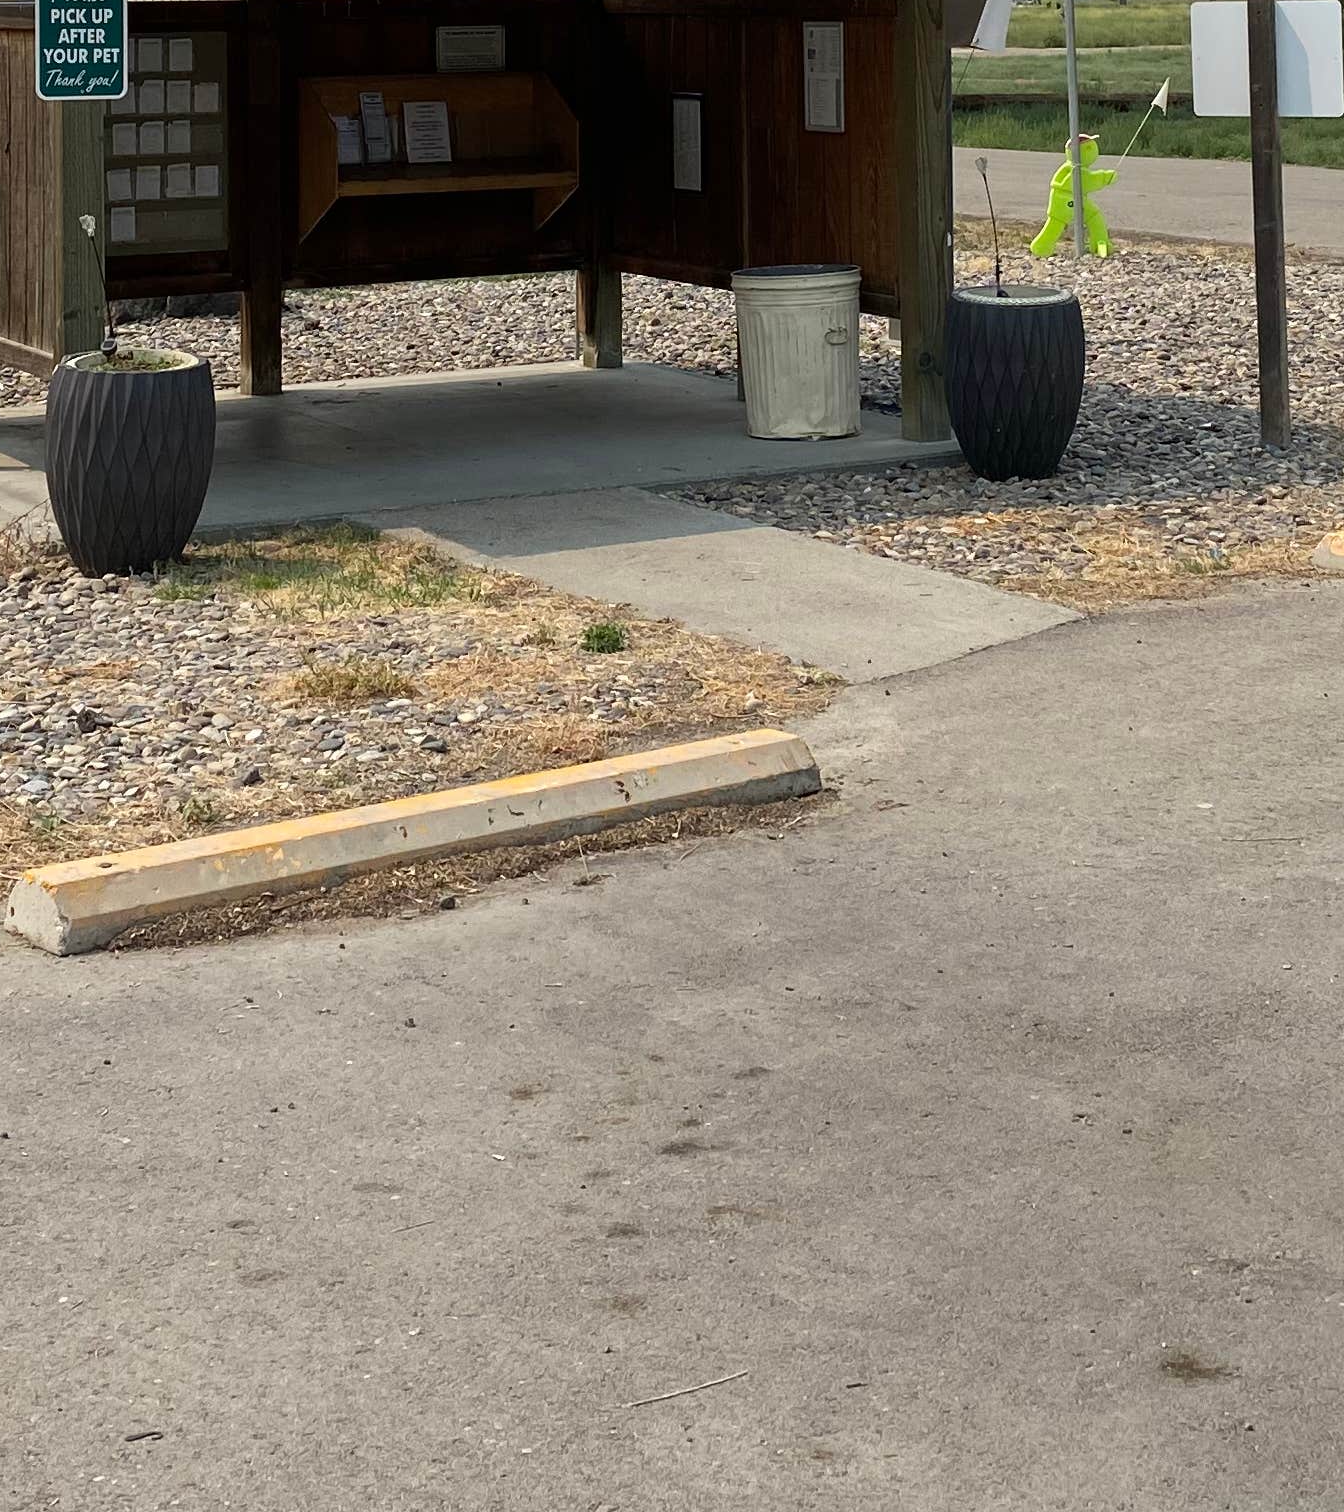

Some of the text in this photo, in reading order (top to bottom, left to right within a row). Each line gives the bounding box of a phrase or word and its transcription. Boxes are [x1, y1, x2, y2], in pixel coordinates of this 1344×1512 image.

[50, 8, 113, 24] PICK UP
[58, 28, 105, 44] AFTER
[43, 48, 120, 64] YOUR PET
[45, 69, 119, 93] Thank you!
